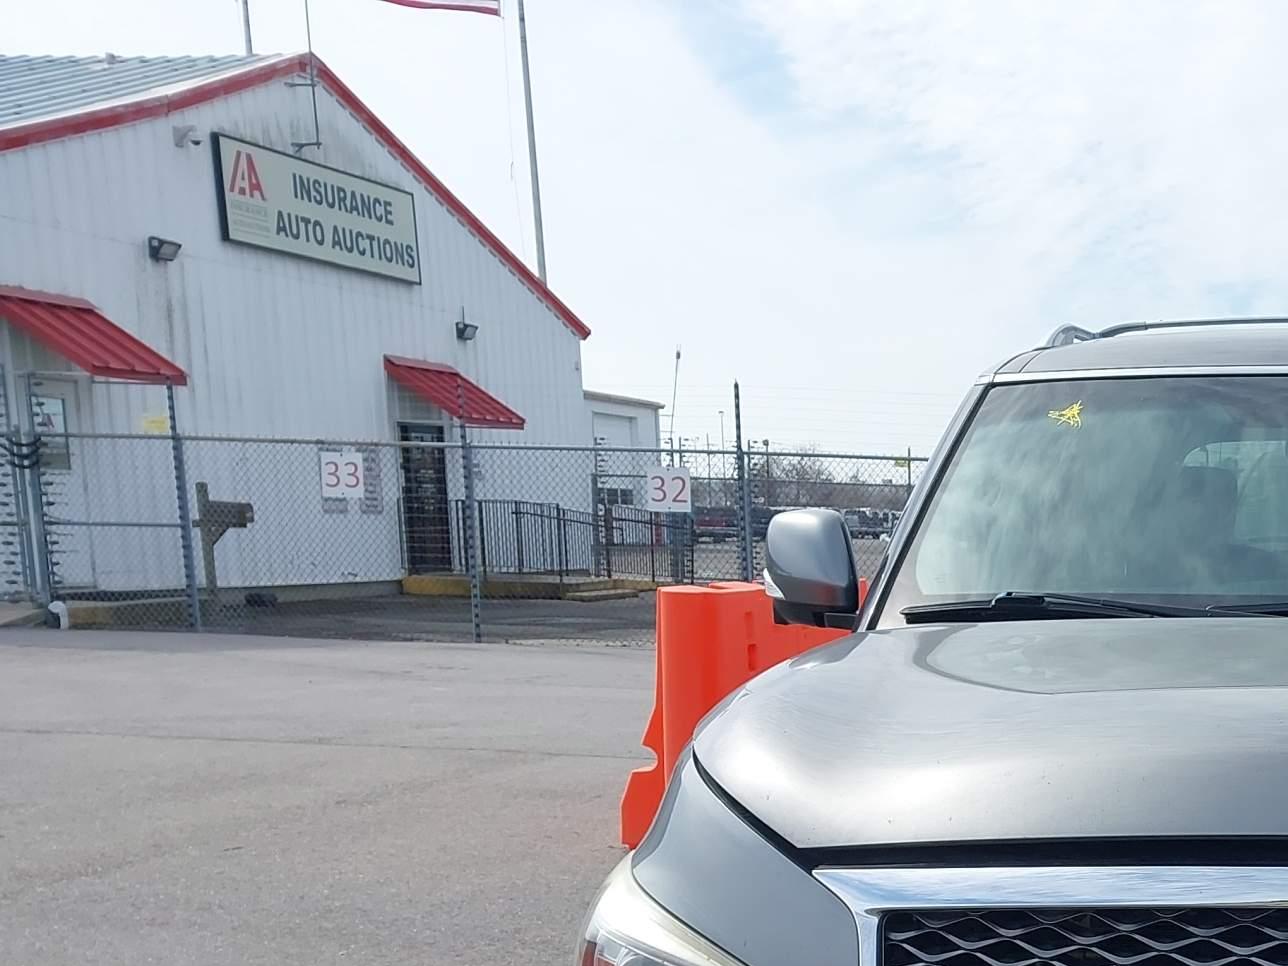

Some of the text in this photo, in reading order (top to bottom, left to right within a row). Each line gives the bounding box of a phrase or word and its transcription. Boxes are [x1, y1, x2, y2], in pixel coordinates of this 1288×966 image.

[292, 173, 395, 226] INSURANCE
[276, 210, 325, 246] AUTO
[331, 225, 416, 270] AUCTIONS
[324, 461, 360, 489] 33
[650, 475, 689, 503] 32
